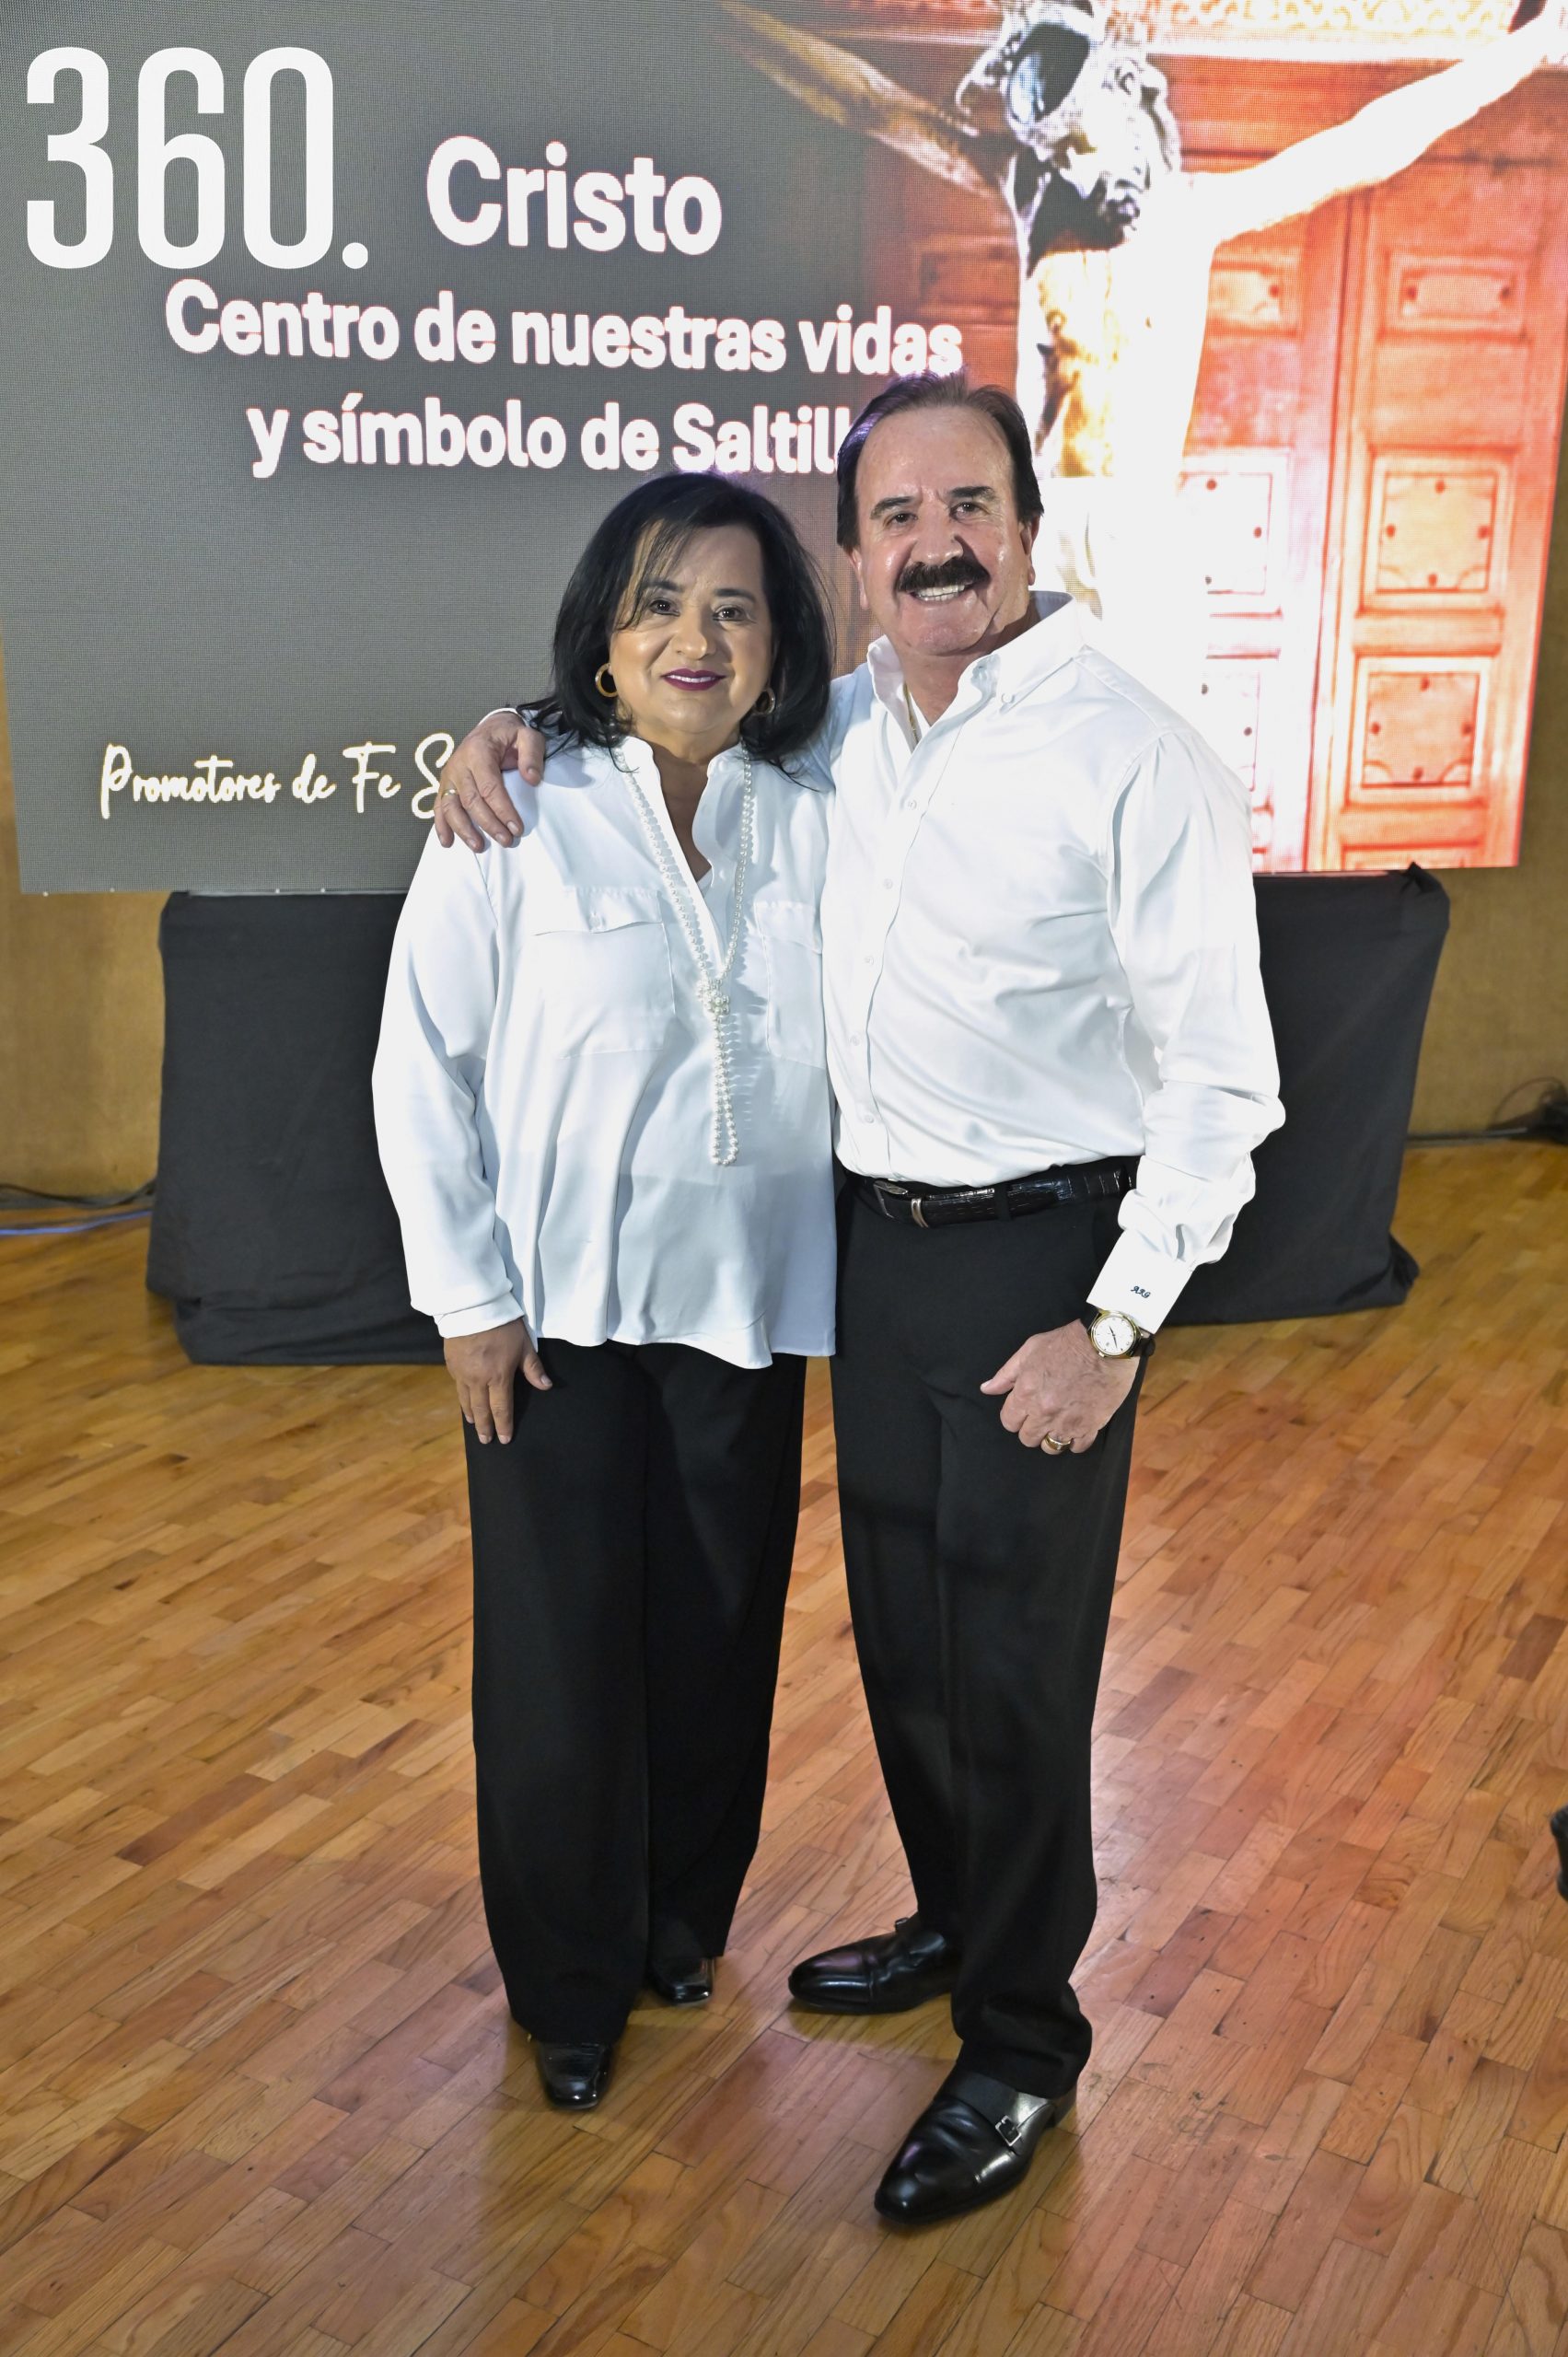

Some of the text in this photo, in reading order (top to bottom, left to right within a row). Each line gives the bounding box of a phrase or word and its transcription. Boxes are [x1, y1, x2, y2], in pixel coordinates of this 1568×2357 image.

[426, 135, 723, 256] Cristo
[165, 278, 963, 377] Centro de nuestras vidas
[247, 392, 853, 479] y símbolo de Saltill
[100, 733, 455, 819] Promotores de Fe S
